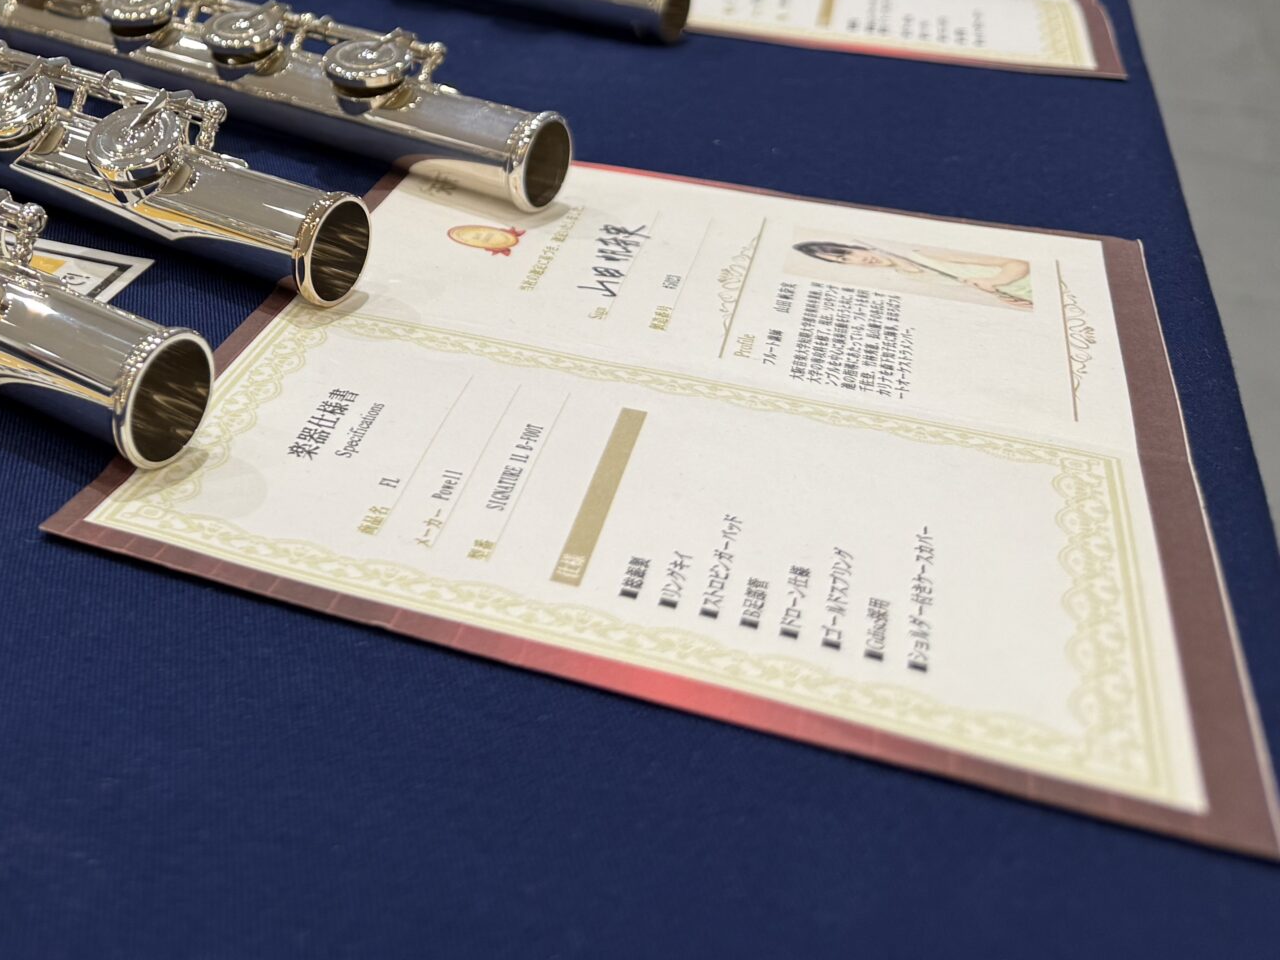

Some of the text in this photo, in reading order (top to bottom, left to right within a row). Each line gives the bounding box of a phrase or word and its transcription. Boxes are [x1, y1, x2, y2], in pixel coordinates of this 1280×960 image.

[733, 333, 756, 359] Profile
[287, 387, 360, 461] 楽器仕様書
[335, 402, 386, 459] Specifications
[379, 476, 401, 490] FL
[431, 469, 464, 502] Powell
[486, 464, 524, 512] SIGNATURE
[517, 423, 545, 452] B-FOOT
[355, 504, 391, 536] 商品名
[414, 507, 444, 548] メーカー
[554, 553, 588, 579] 仕様
[659, 549, 694, 599] リングキイ
